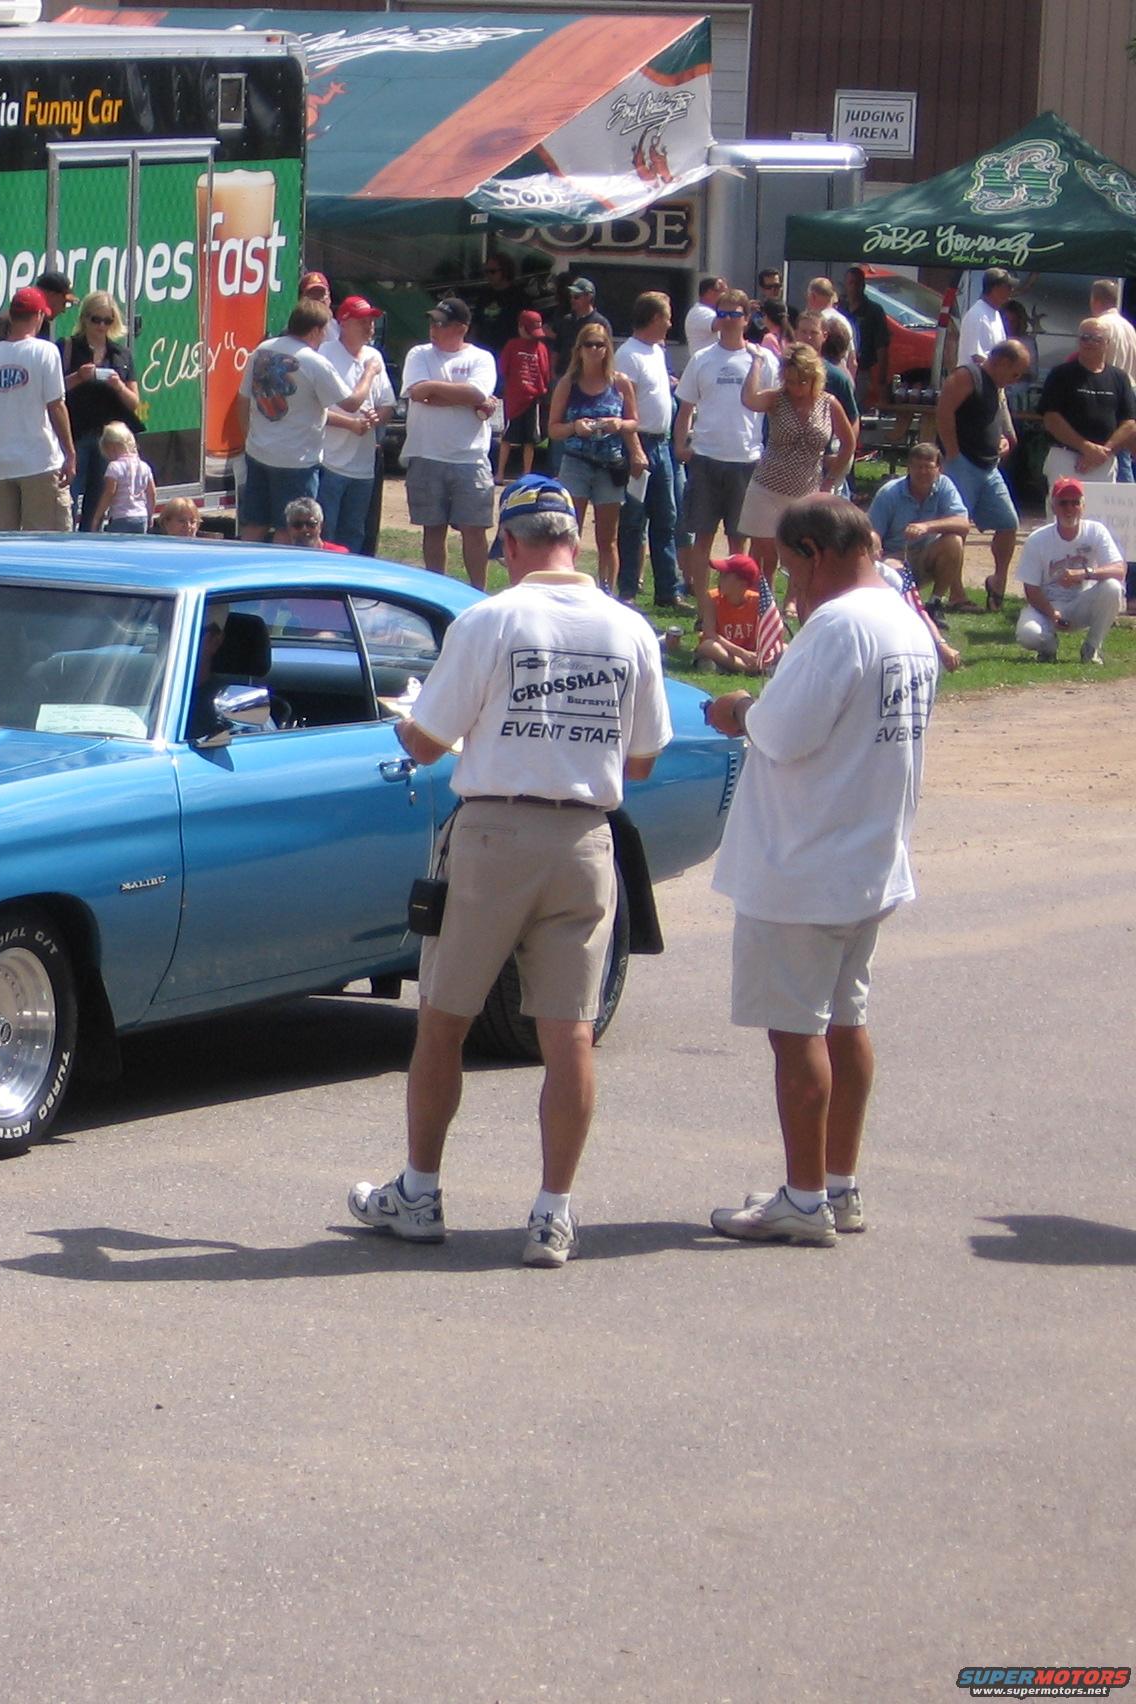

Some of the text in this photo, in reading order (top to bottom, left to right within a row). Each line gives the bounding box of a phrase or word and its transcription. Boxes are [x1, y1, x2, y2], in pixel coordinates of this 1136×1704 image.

[24, 93, 83, 135] Funny
[88, 89, 124, 124] Car
[845, 110, 905, 124] JUDGING
[849, 126, 900, 141] ARENA
[203, 211, 288, 298] fast
[513, 666, 627, 703] GROSSMAN
[500, 721, 623, 745] EVENT STAFF
[120, 874, 167, 892] MALIBU
[37, 1050, 72, 1121] TURBO
